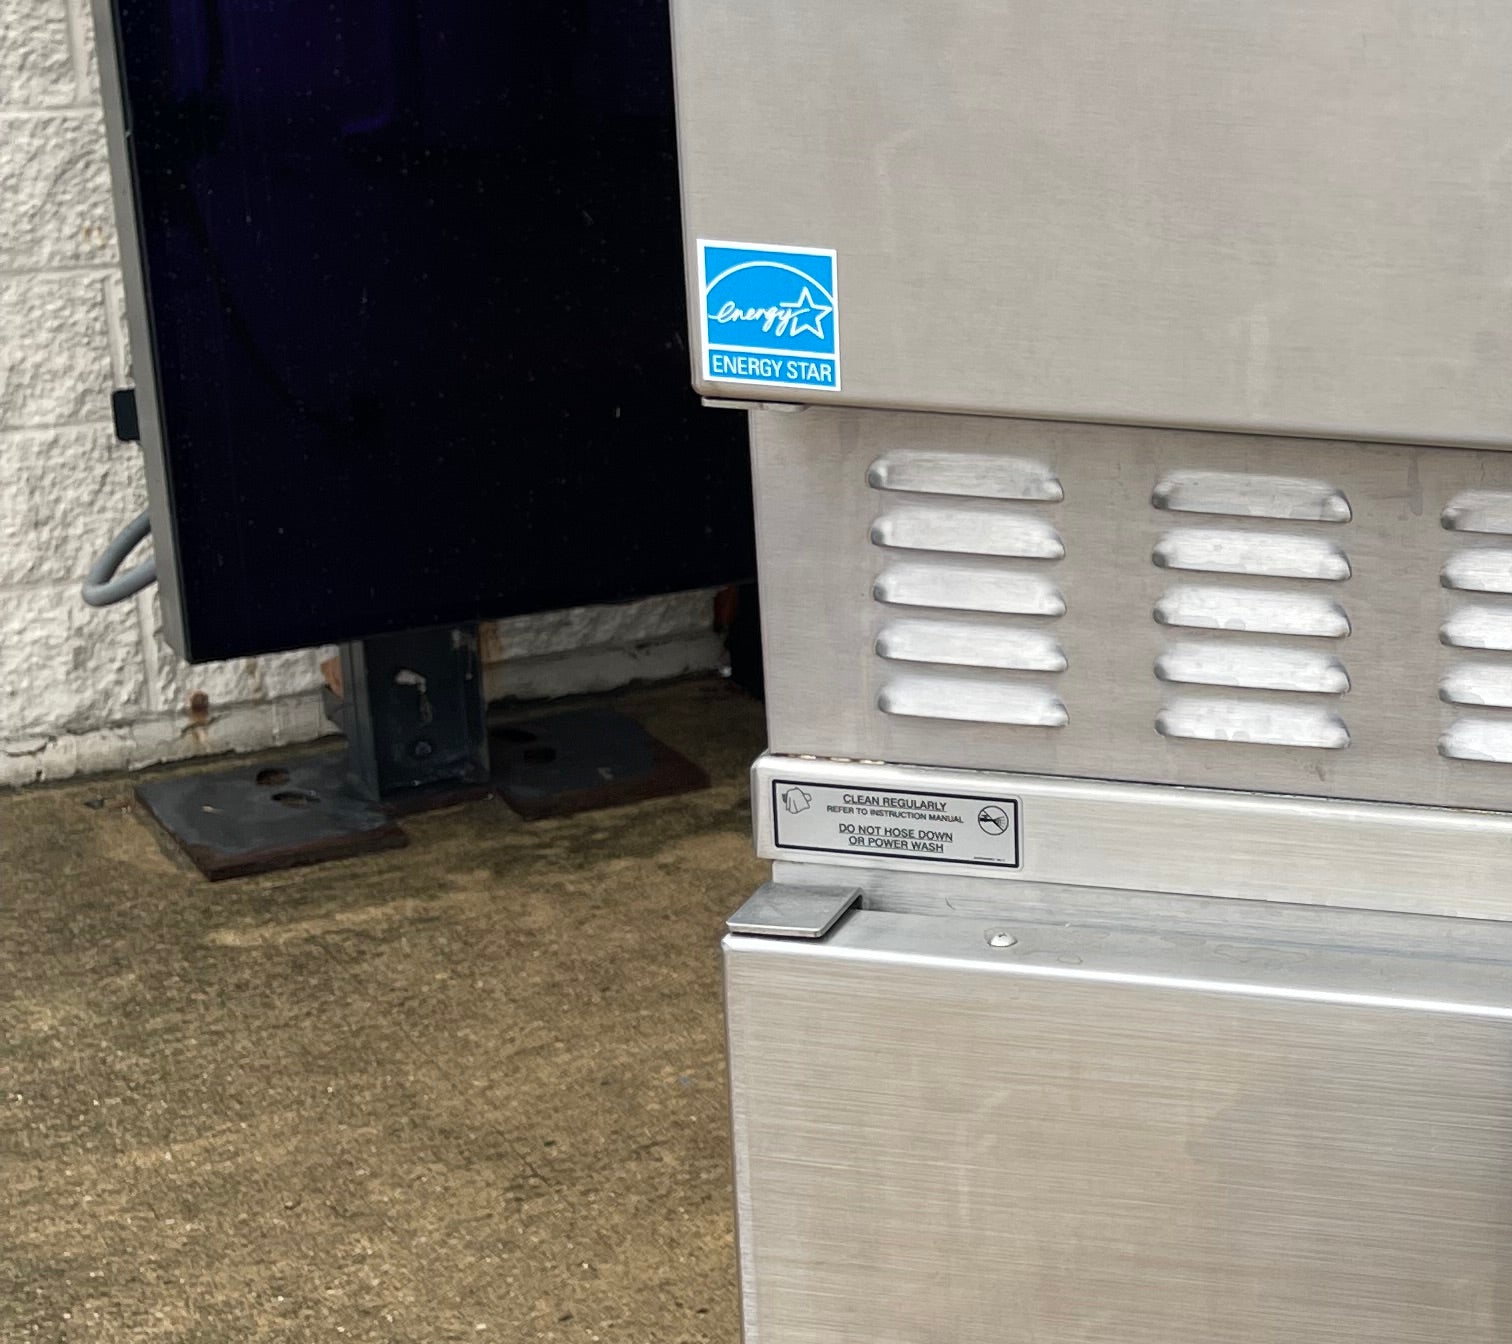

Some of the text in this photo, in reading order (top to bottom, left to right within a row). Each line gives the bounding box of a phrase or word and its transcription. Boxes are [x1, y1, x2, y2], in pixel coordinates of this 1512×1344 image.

[711, 301, 803, 337] energy
[712, 354, 832, 383] ENERGY STAR
[843, 794, 947, 812] CLEAN REGULARLY
[827, 805, 854, 815] REFER
[870, 809, 927, 820] INSTRUCTION
[929, 813, 964, 824] MANUAL
[839, 824, 953, 841] DO NOT HOSE DOWN
[849, 837, 944, 852] OR POWER WASH
